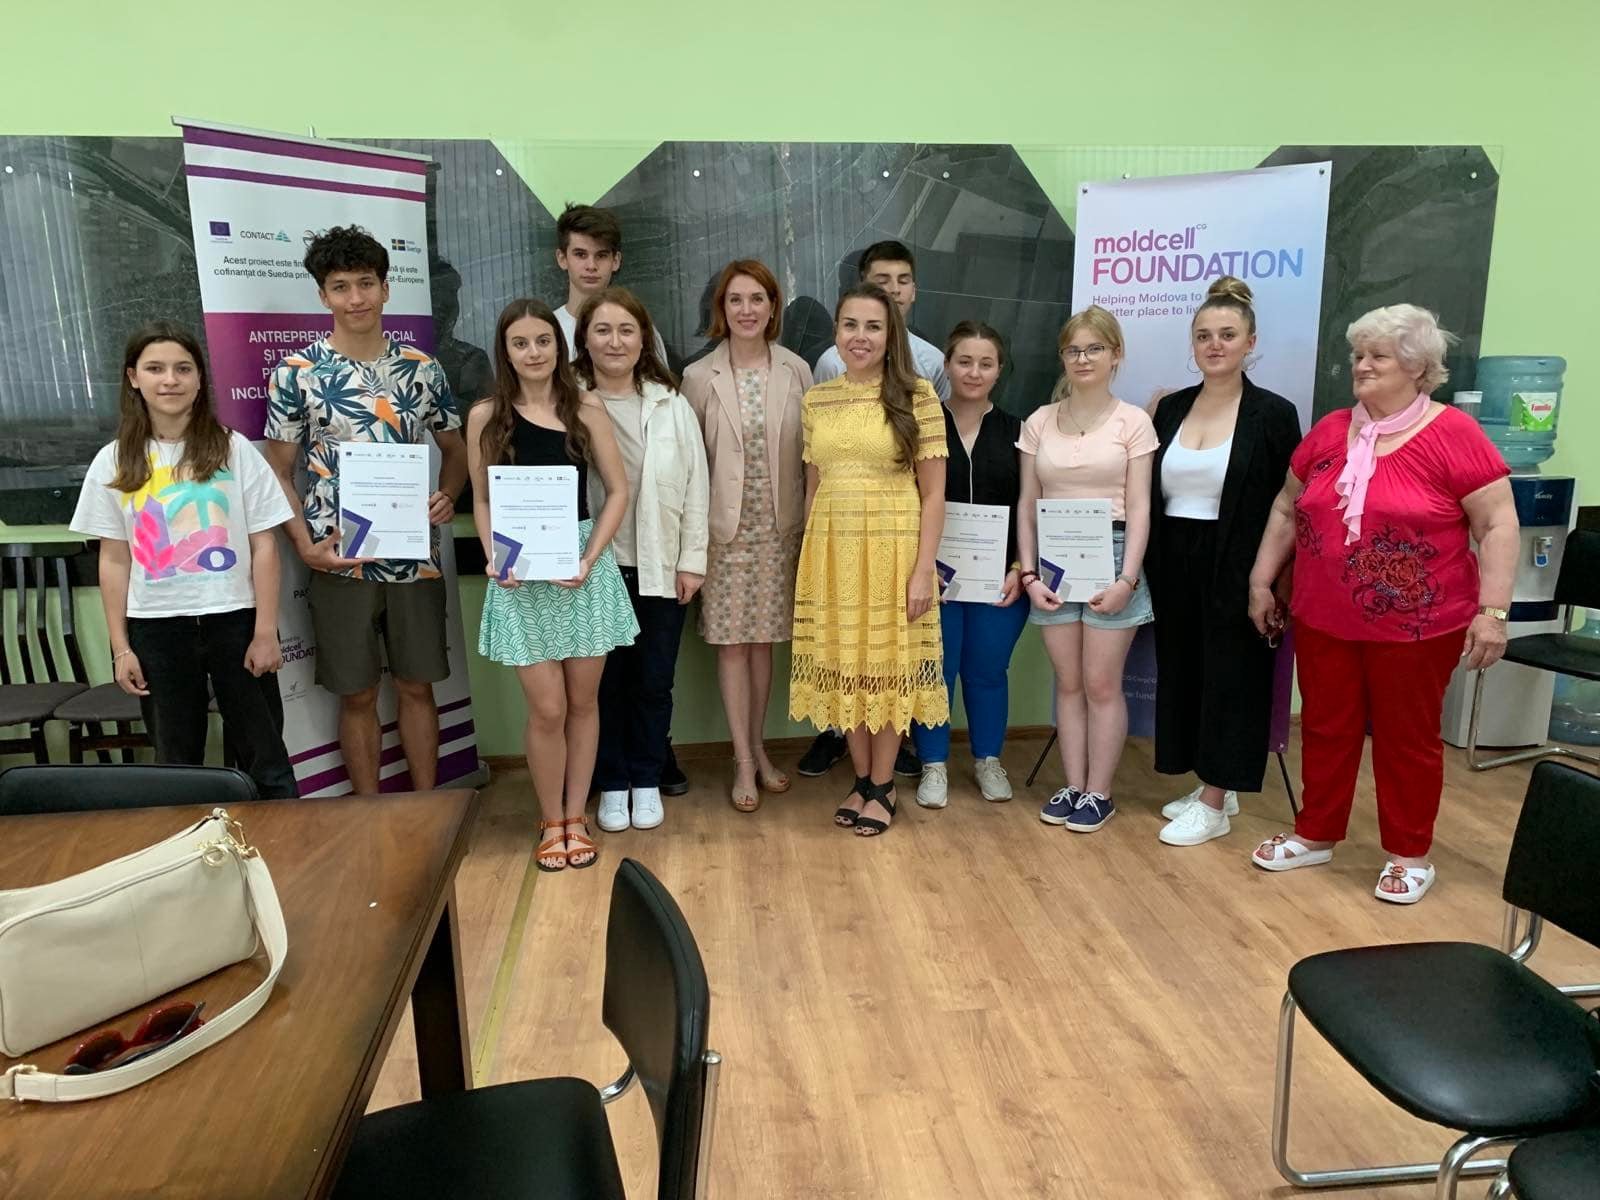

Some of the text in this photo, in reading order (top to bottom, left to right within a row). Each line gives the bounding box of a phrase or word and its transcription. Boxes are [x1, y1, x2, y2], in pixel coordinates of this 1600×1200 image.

[240, 230, 275, 240] CONTACT
[1094, 227, 1195, 254] moldcell
[224, 256, 246, 265] Acest
[249, 257, 275, 268] proiect
[276, 259, 292, 267] este
[1093, 248, 1304, 285] FOUNDATION
[256, 269, 266, 277] de
[268, 269, 294, 278] Suedia
[1093, 292, 1202, 305] Helping Moldova to
[1110, 307, 1134, 317] etter
[1138, 306, 1169, 318] place
[1172, 306, 1183, 315] to
[383, 330, 416, 341] OCIAL
